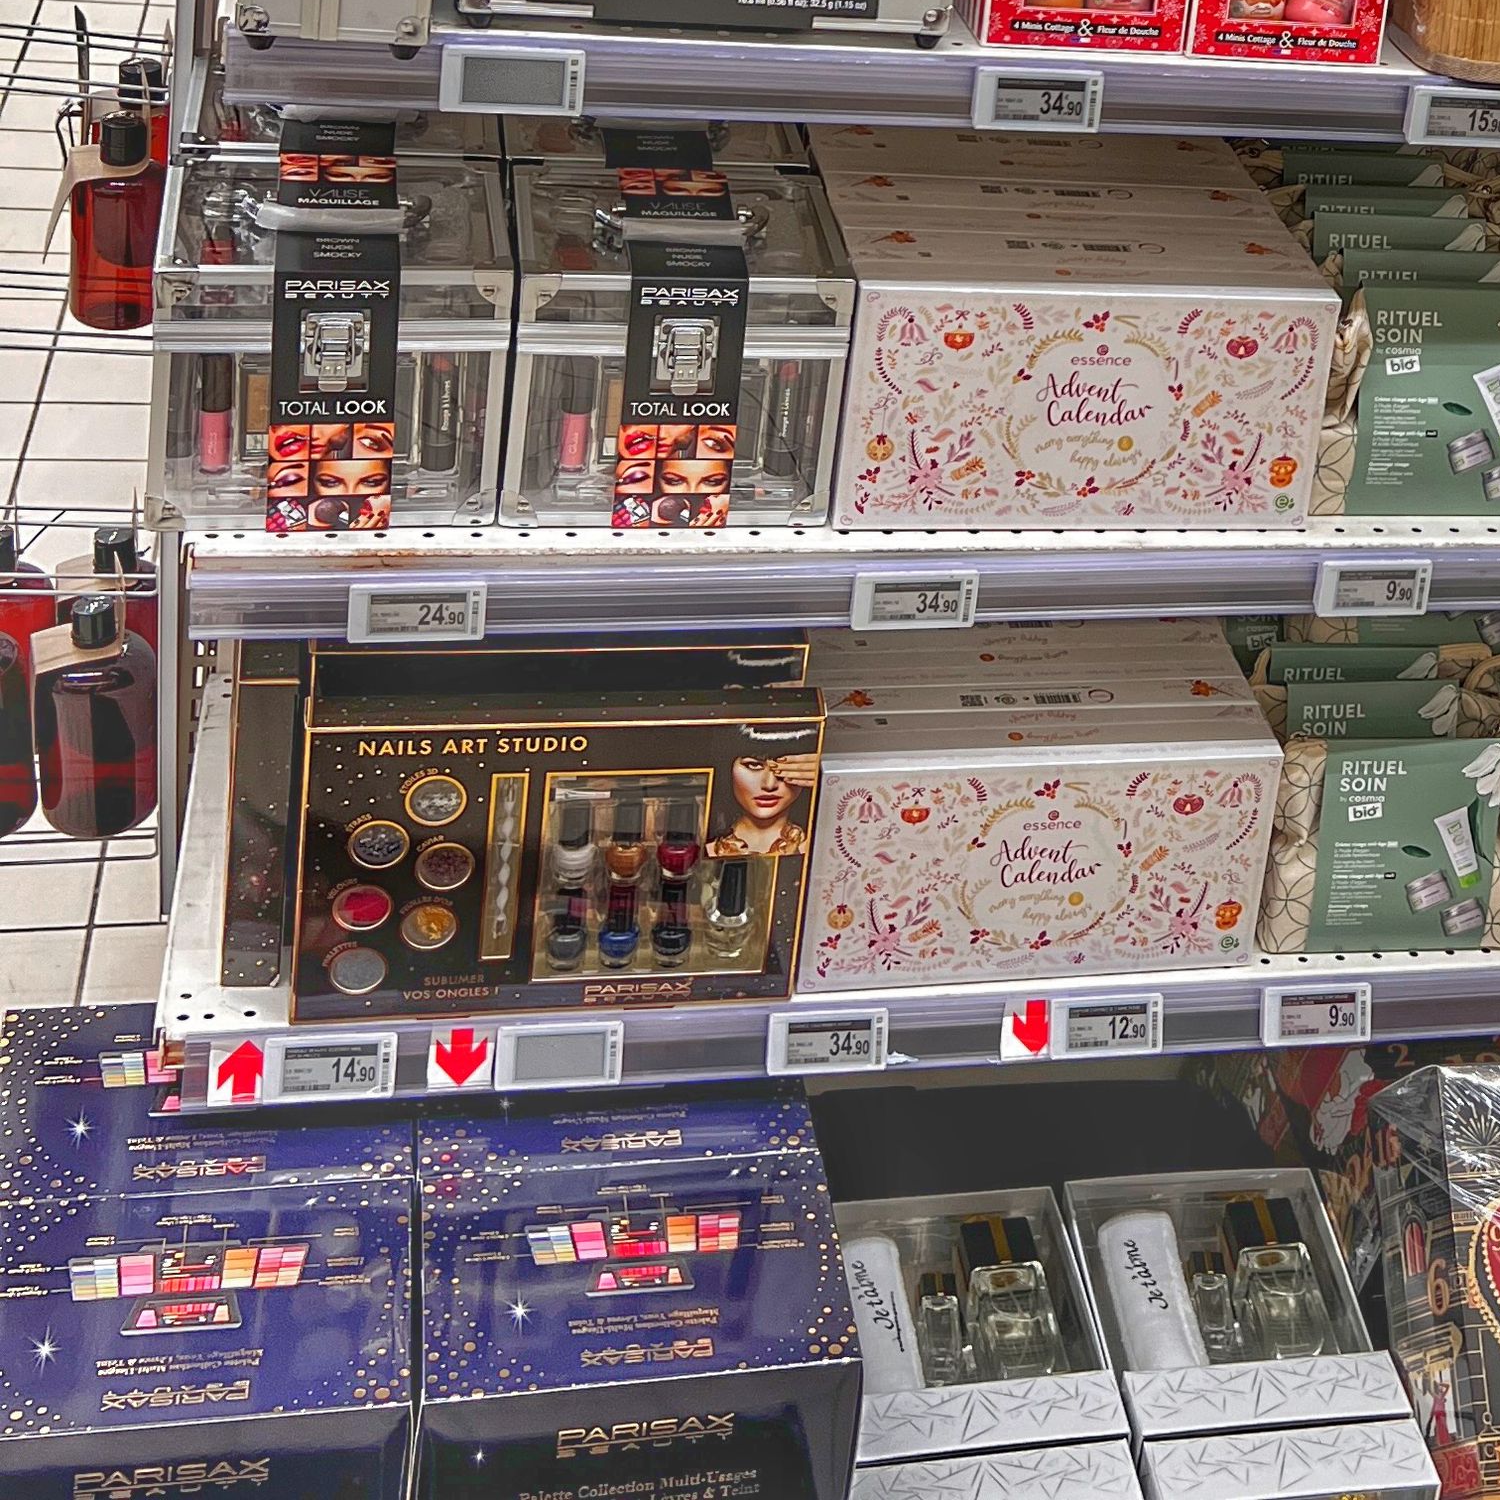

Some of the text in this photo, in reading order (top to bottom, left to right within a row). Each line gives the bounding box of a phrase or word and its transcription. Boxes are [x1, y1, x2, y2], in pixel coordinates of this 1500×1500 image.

[1022, 23, 1042, 32] Minis
[1045, 24, 1074, 35] Cottage
[1077, 20, 1094, 37] &
[1097, 26, 1117, 35] Fleur
[1119, 27, 1128, 36] de
[1130, 27, 1159, 37] Douche
[297, 197, 380, 207] MAQUILLAGE
[285, 279, 390, 293] PARISAX
[641, 287, 739, 301] PARISAX
[1376, 310, 1443, 327] RITUEL
[1376, 327, 1423, 344] SOIN
[1385, 347, 1421, 355] cosmia
[1071, 354, 1131, 367] essence
[1390, 357, 1416, 372] bio
[1036, 371, 1139, 402] Advent
[279, 400, 387, 417] TOTAL LOOK
[630, 401, 730, 417] TOTAL LOOK
[1047, 400, 1154, 428] Calendar
[359, 736, 588, 756] NAILS ART STUDIO
[1341, 761, 1407, 776] RITUEL
[1340, 777, 1387, 793] SOIN
[1023, 819, 1081, 831] essence
[991, 839, 1089, 867] Advent
[1000, 860, 1102, 887] Calendar
[424, 974, 484, 986] SUBLIMER
[585, 980, 693, 996] PARISAX
[403, 987, 490, 999] VOS ONGLES
[557, 1413, 734, 1446] PARISAX
[74, 1458, 269, 1485] PARISAX
[578, 1469, 757, 1499] Collection Multi-Usages
